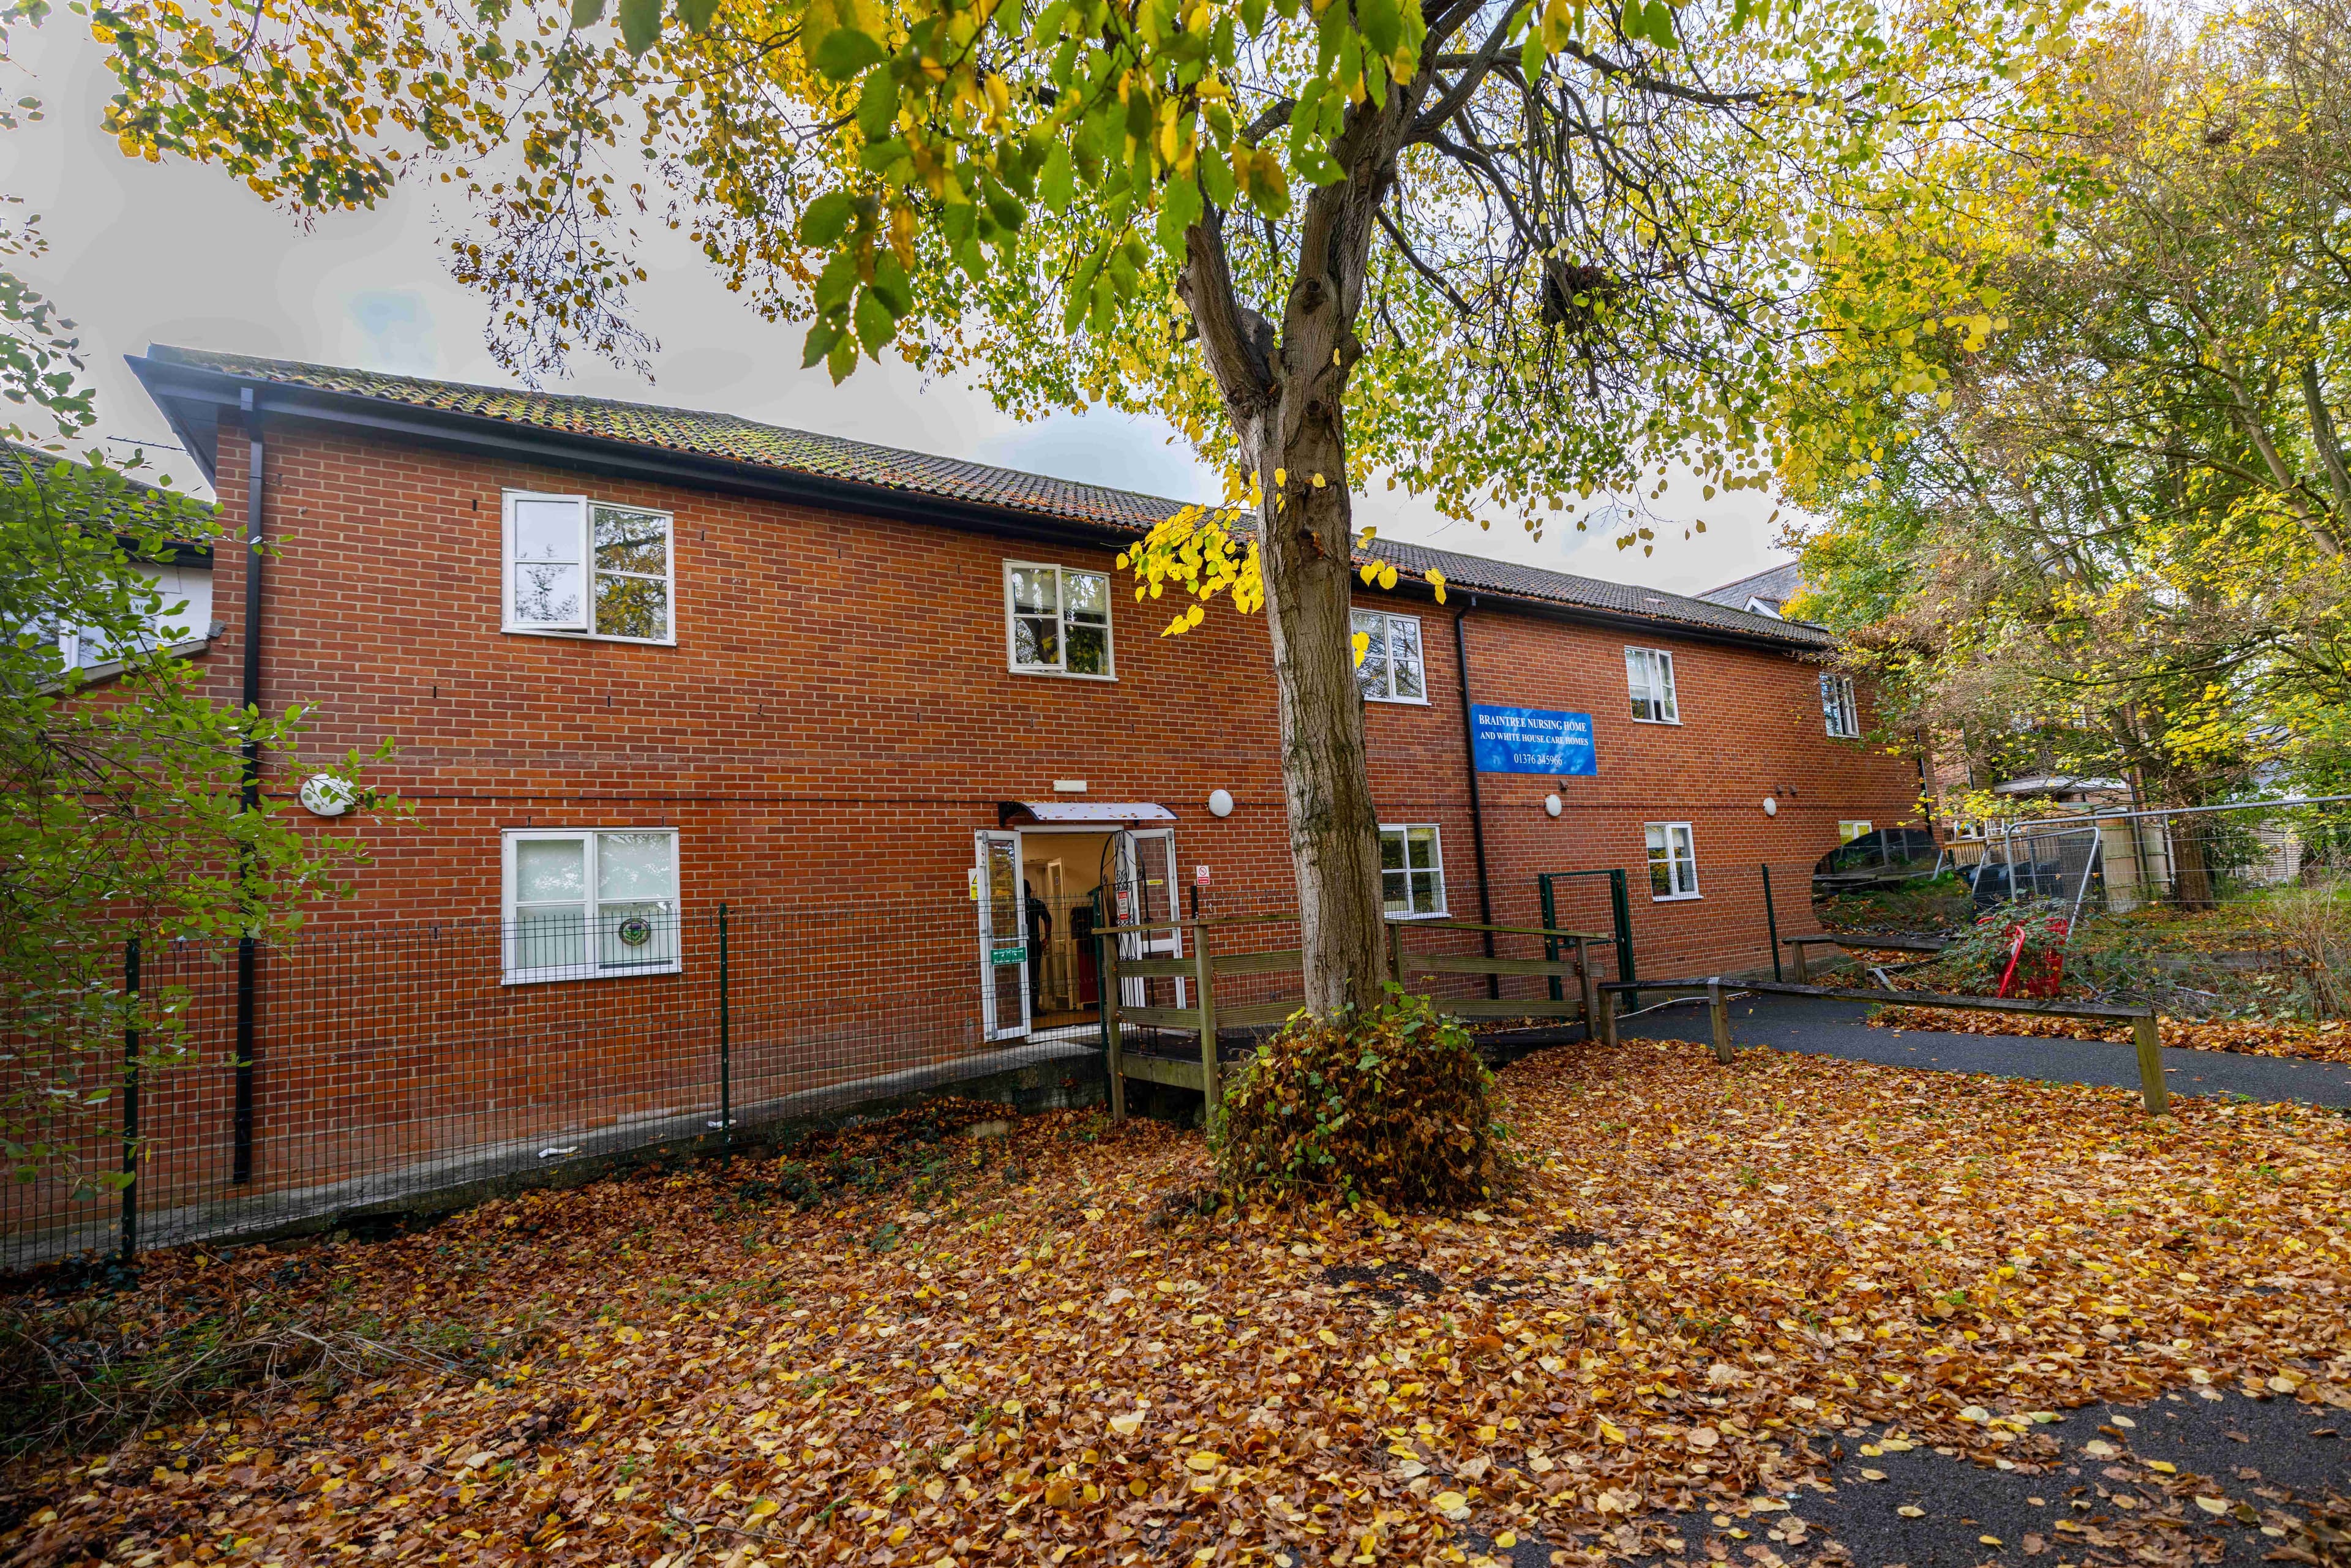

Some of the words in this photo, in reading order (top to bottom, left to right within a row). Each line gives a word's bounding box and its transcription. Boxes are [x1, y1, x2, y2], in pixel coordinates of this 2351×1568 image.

[1479, 715, 1526, 727] BRAINTREE
[1528, 718, 1562, 730] NURSING
[1564, 721, 1587, 732] HOME
[1480, 732, 1496, 740] AND
[1496, 732, 1520, 741] WHITE
[1522, 734, 1545, 743] HOUSE
[1546, 735, 1564, 745] CARE
[1565, 737, 1589, 746] HOMES
[1513, 753, 1536, 764] 01376
[1537, 754, 1562, 765] 345966
